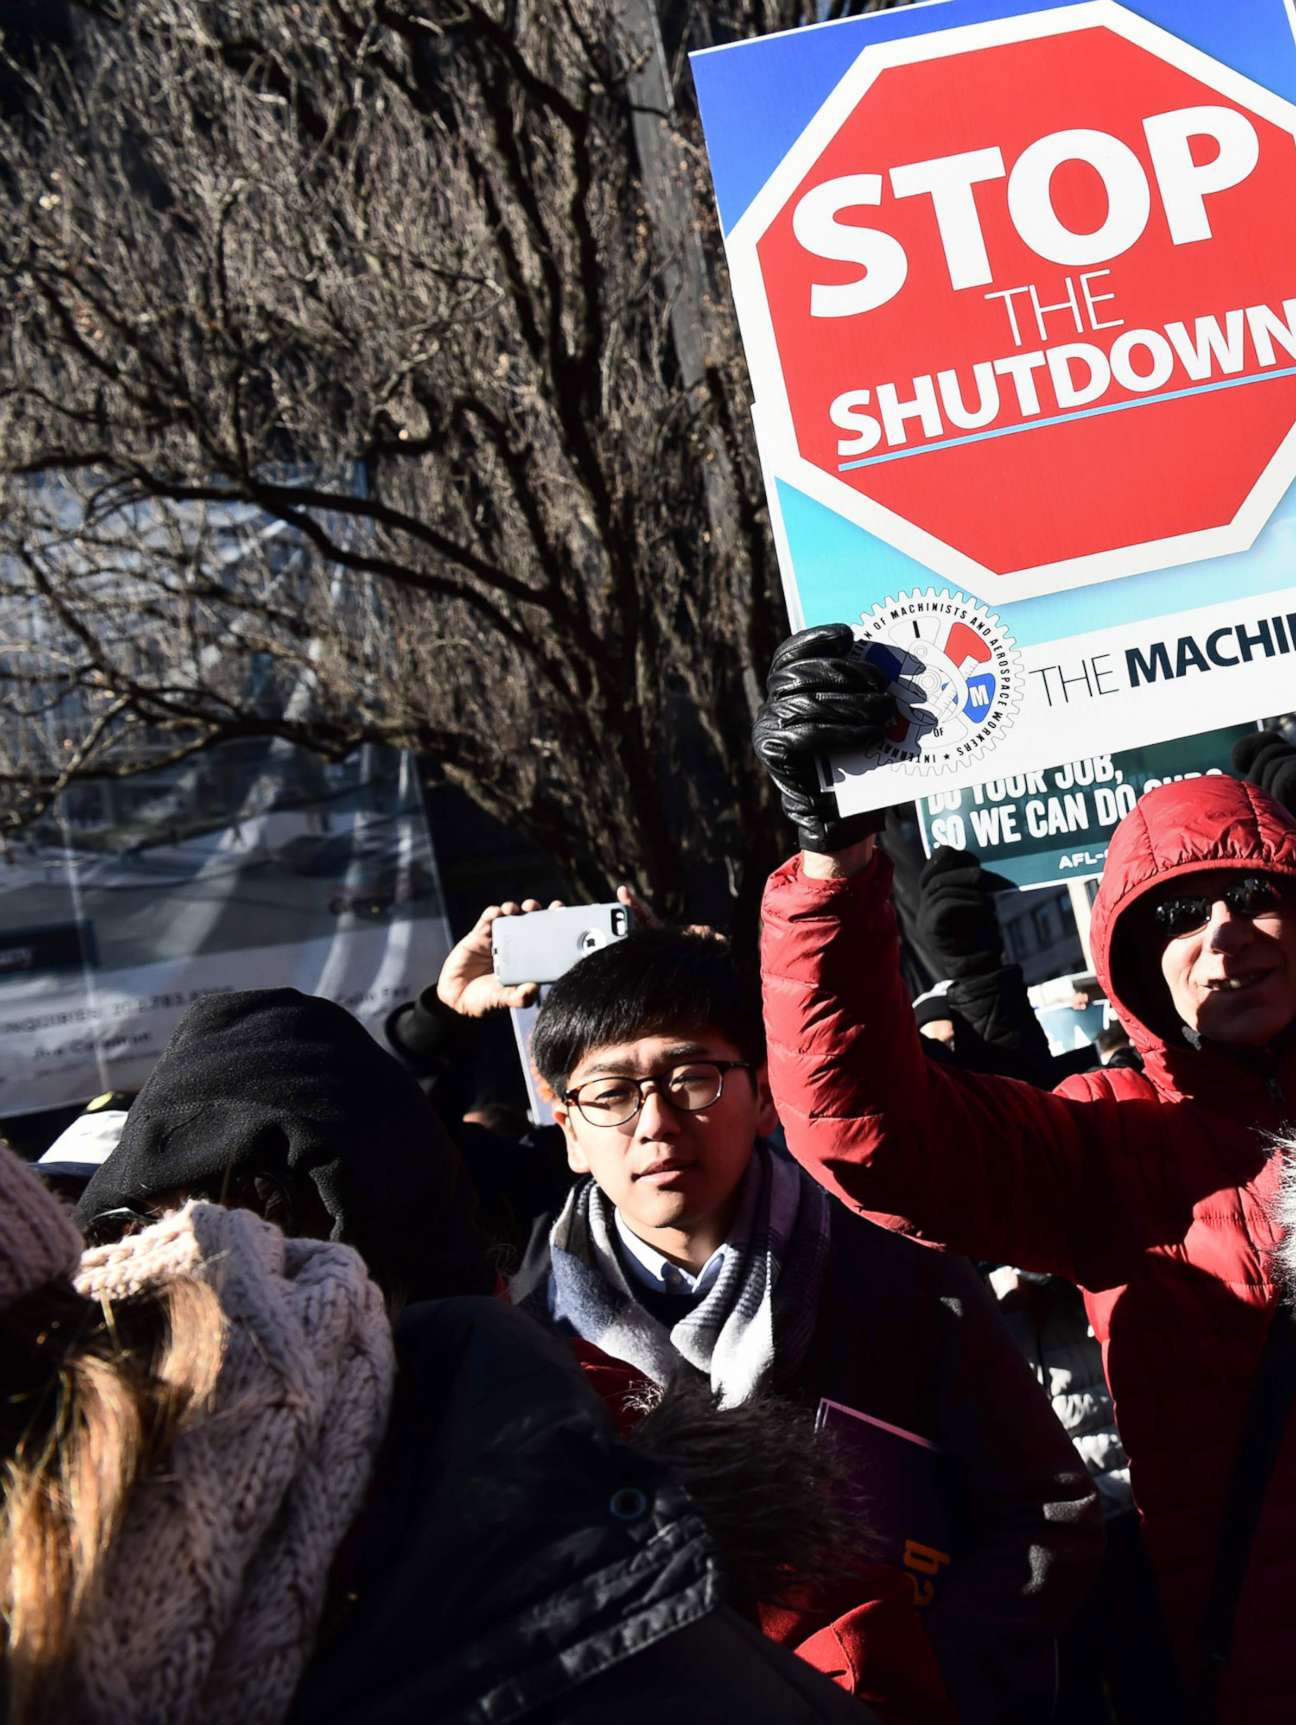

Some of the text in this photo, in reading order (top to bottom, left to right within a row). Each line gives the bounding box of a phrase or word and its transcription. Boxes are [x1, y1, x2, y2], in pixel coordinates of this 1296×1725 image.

[792, 105, 1260, 318] STOP
[985, 269, 1124, 346] THE
[873, 602, 1011, 757] OF MACHINISTS AND AEROSPACE WORKERS
[969, 684, 989, 707] M
[1029, 653, 1119, 707] THE
[933, 727, 944, 738] OF
[1054, 754, 1124, 789] JOB,
[931, 783, 1137, 851] SO WE CAN DO
[1059, 849, 1109, 870] AFL-
